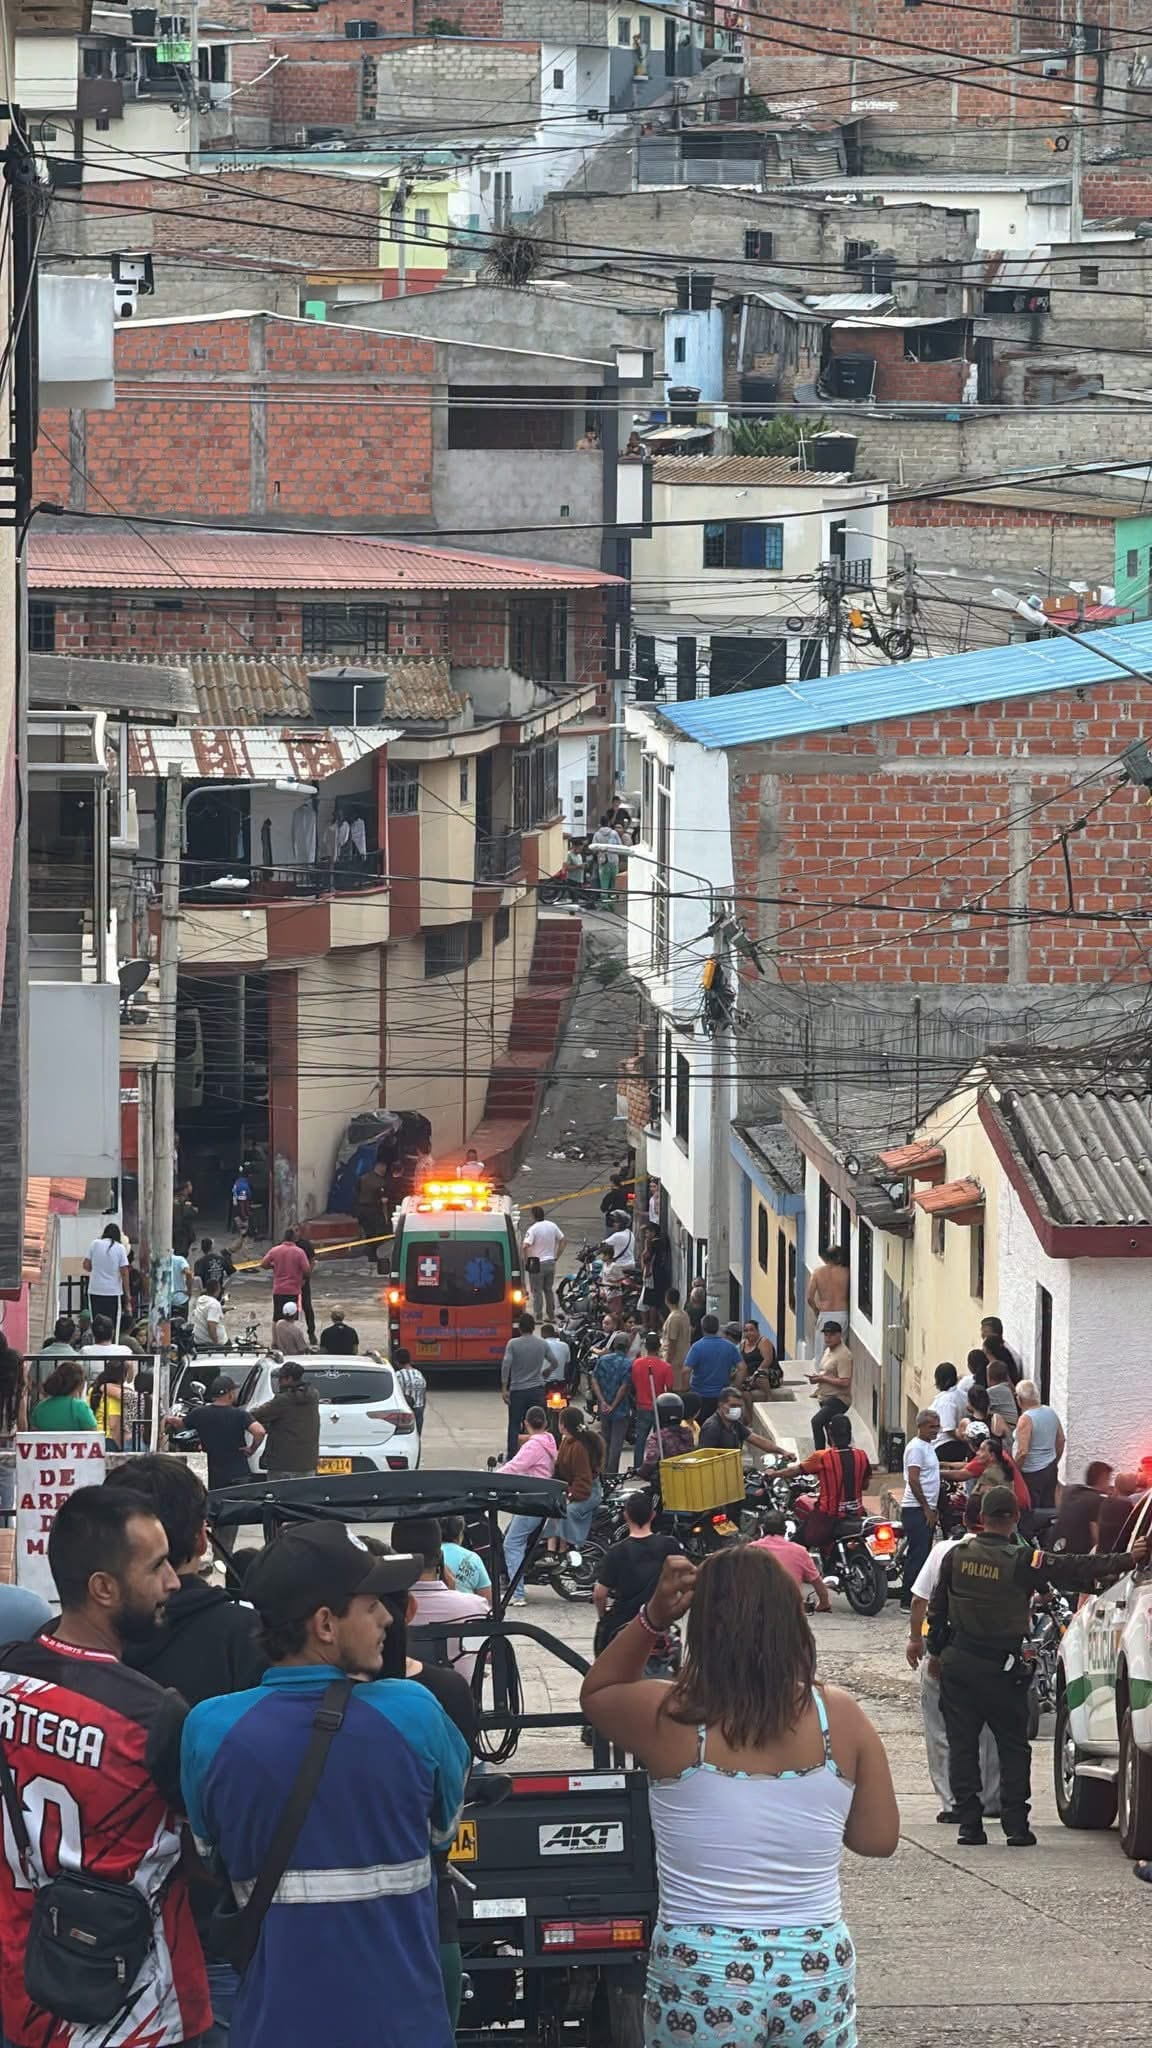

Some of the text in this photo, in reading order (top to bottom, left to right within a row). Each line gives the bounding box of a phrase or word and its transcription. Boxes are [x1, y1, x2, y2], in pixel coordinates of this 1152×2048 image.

[16, 1442, 105, 1460] VENTA
[40, 1469, 75, 1486] DE
[20, 1492, 69, 1510] ARE
[39, 1514, 56, 1533] D
[26, 1538, 49, 1556] M
[961, 1560, 1000, 1581] POLICIA
[0, 1694, 105, 1768] RTEGA
[543, 1823, 620, 1849] AKT
